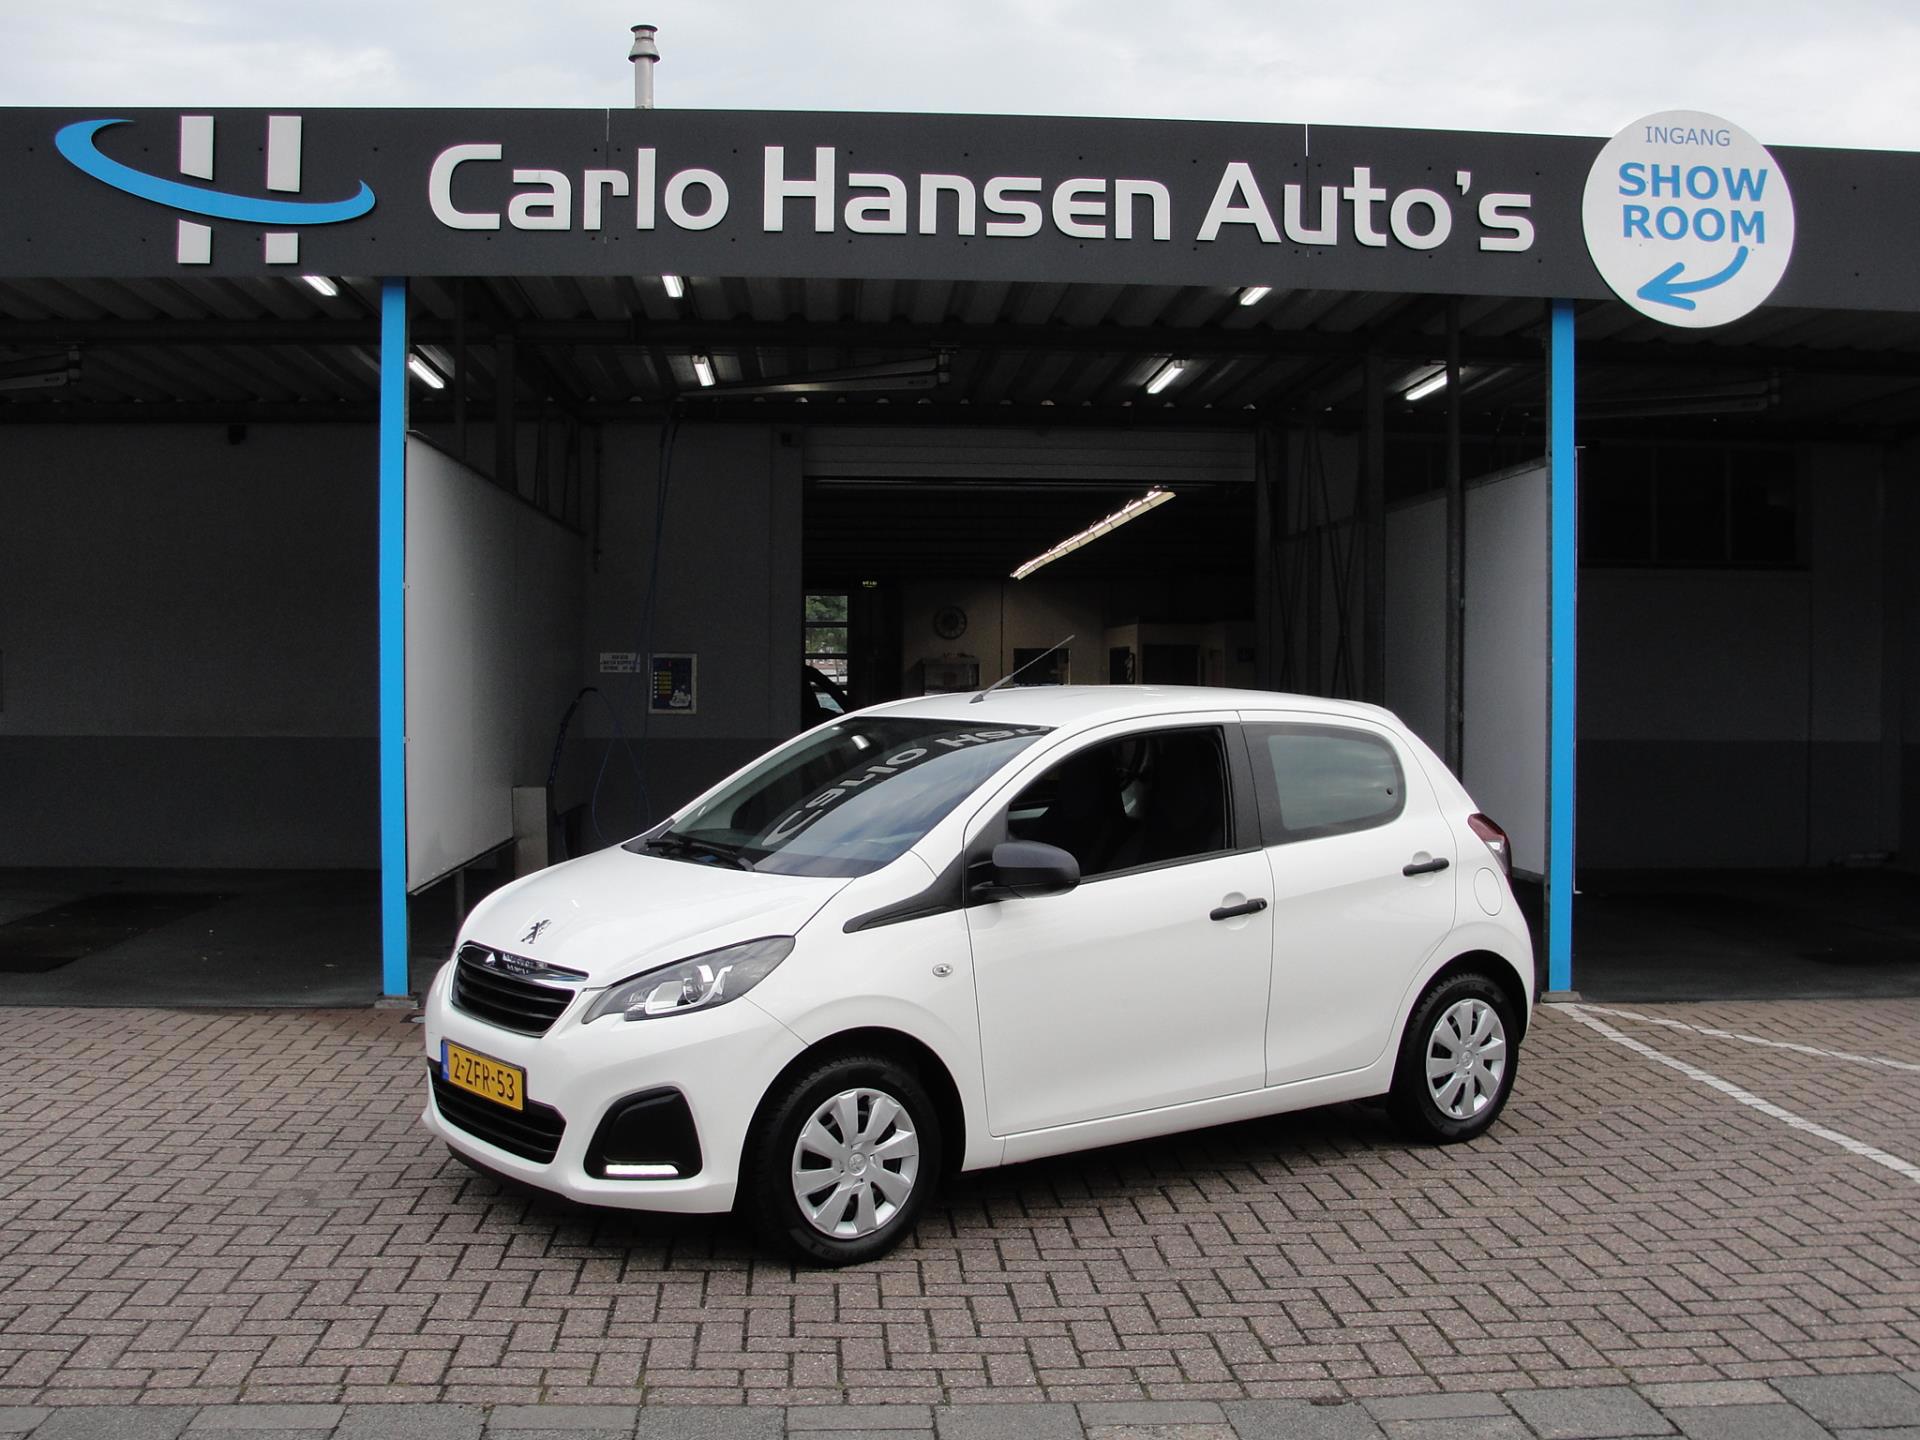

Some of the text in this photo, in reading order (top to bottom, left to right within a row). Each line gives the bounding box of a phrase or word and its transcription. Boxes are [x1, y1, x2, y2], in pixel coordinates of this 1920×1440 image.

[1645, 126, 1730, 147] INGANG
[428, 143, 1535, 252] Carlo Hansen Auto's
[1618, 162, 1768, 202] SHOW
[1622, 204, 1765, 244] ROOM
[453, 1052, 516, 1102] 2-ZFR-53
